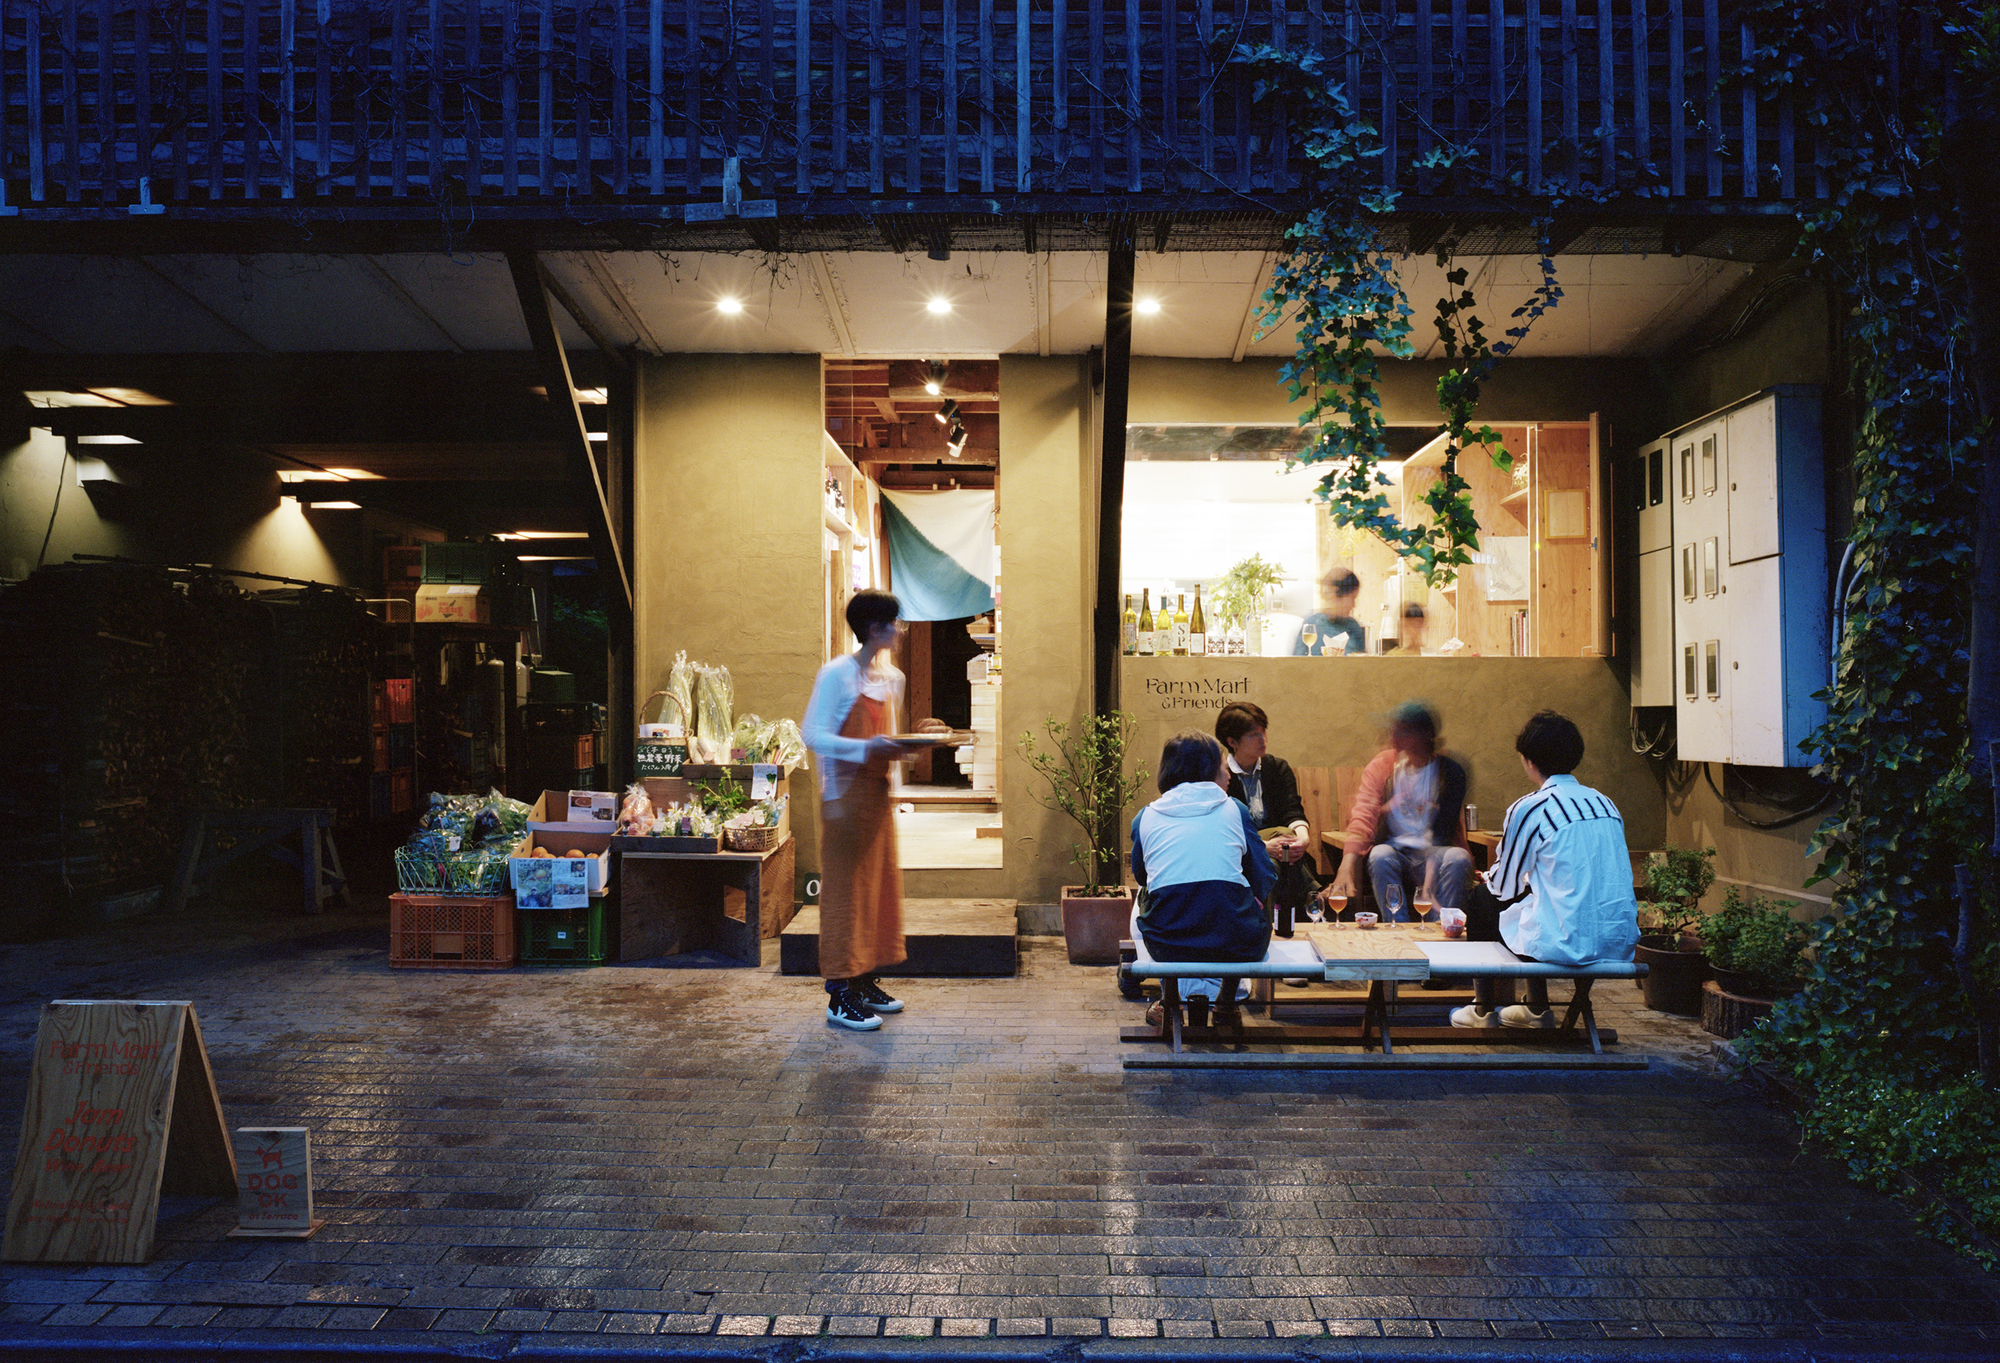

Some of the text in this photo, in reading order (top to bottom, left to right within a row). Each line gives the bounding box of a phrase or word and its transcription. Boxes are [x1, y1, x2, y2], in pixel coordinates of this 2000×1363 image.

[1146, 677, 1252, 695] Farm Mart
[49, 1040, 163, 1059] Farm Mart
[65, 1100, 124, 1125] Jam
[43, 1128, 137, 1153] Donuts
[92, 1158, 130, 1173] Beer
[248, 1173, 298, 1190] DOG
[31, 1199, 69, 1210] Natural
[257, 1193, 288, 1208] OK
[248, 1211, 299, 1221] at Terrace
